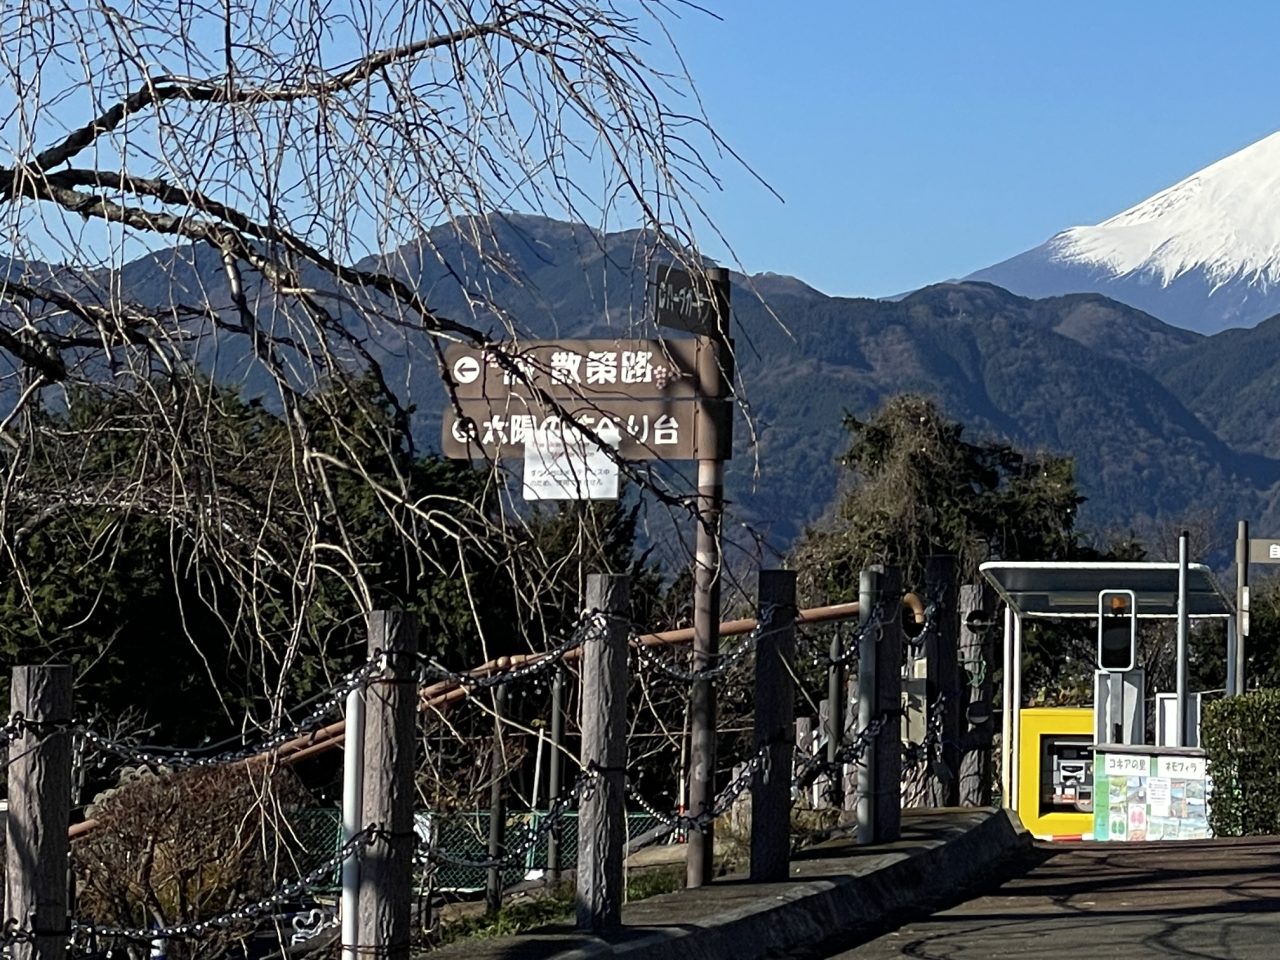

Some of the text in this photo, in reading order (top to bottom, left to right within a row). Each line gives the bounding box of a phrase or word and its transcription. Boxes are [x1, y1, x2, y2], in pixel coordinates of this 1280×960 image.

[551, 351, 653, 384] 散策路
[1109, 759, 1146, 771] コキアの里
[1165, 762, 1197, 773] ネモフィラ
